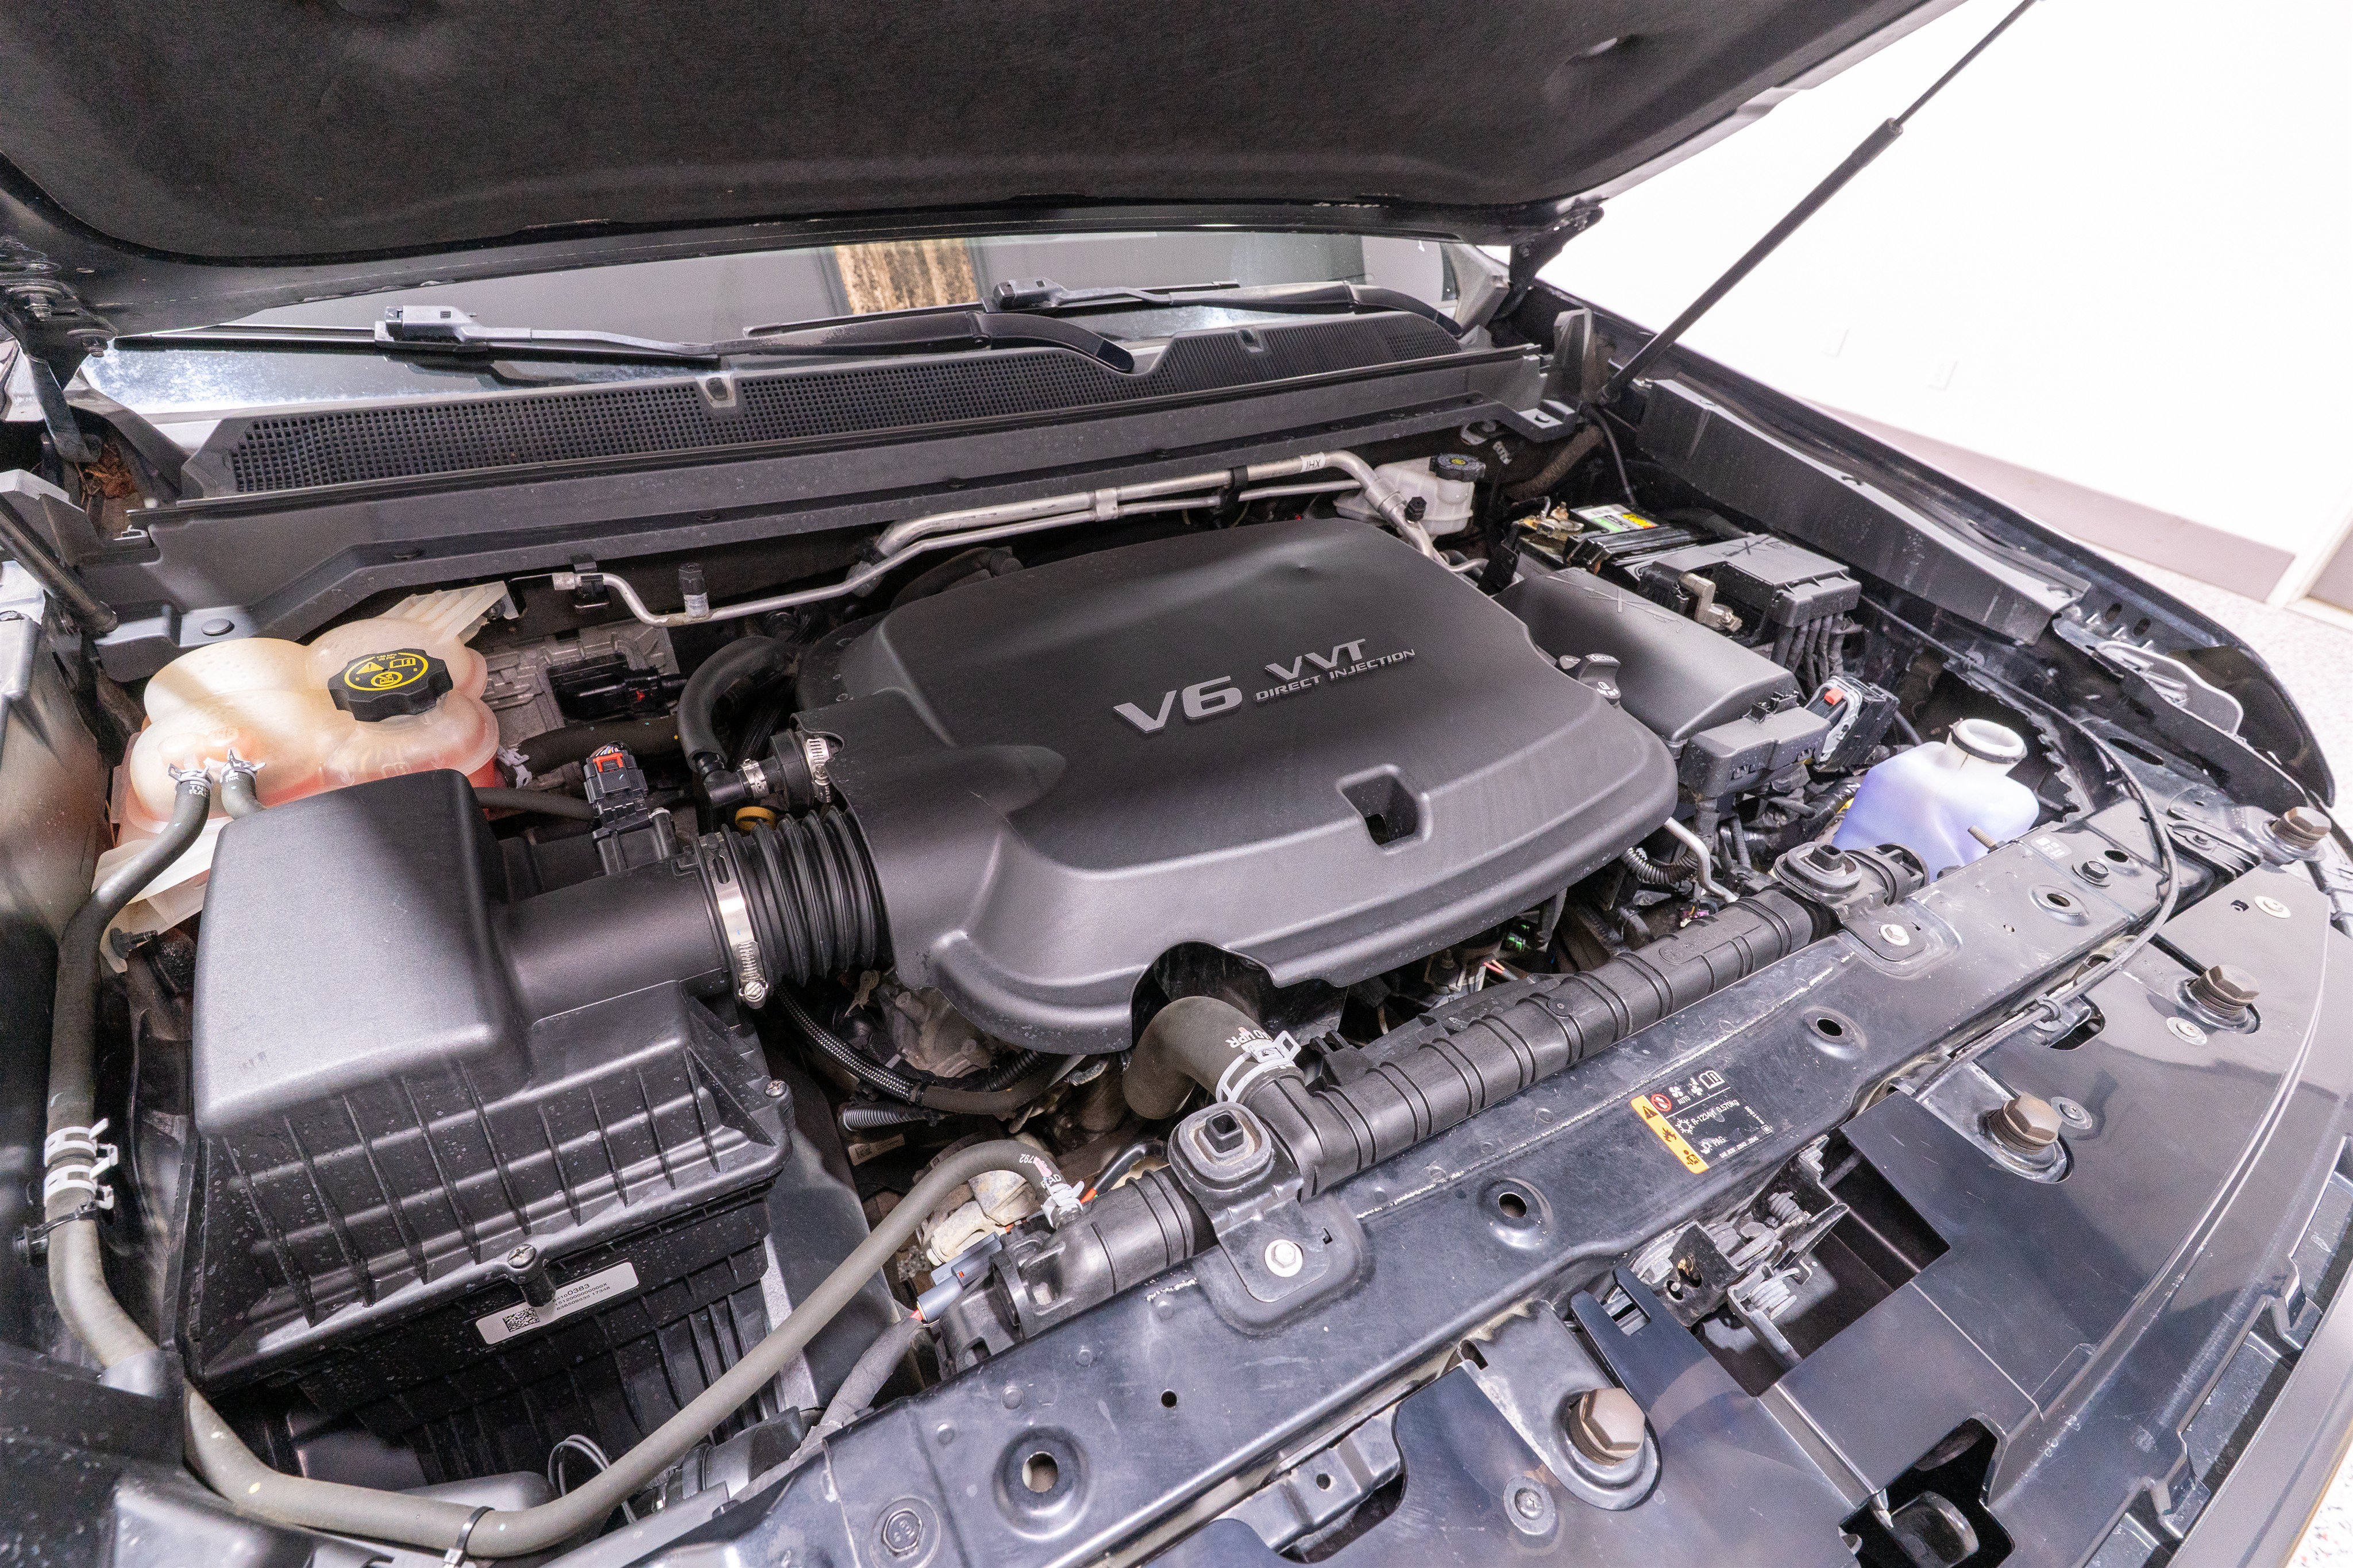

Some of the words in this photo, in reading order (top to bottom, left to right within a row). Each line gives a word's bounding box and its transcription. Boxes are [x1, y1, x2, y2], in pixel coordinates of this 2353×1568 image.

[1265, 638, 1366, 681] VVT
[1255, 674, 1321, 702] DIRECT
[1329, 649, 1415, 680] INJECTION
[1113, 675, 1243, 733] V6
[1677, 1095, 1691, 1105] AUTO
[1715, 1099, 1740, 1114] 0.570kg
[1711, 1136, 1726, 1147] PAG
